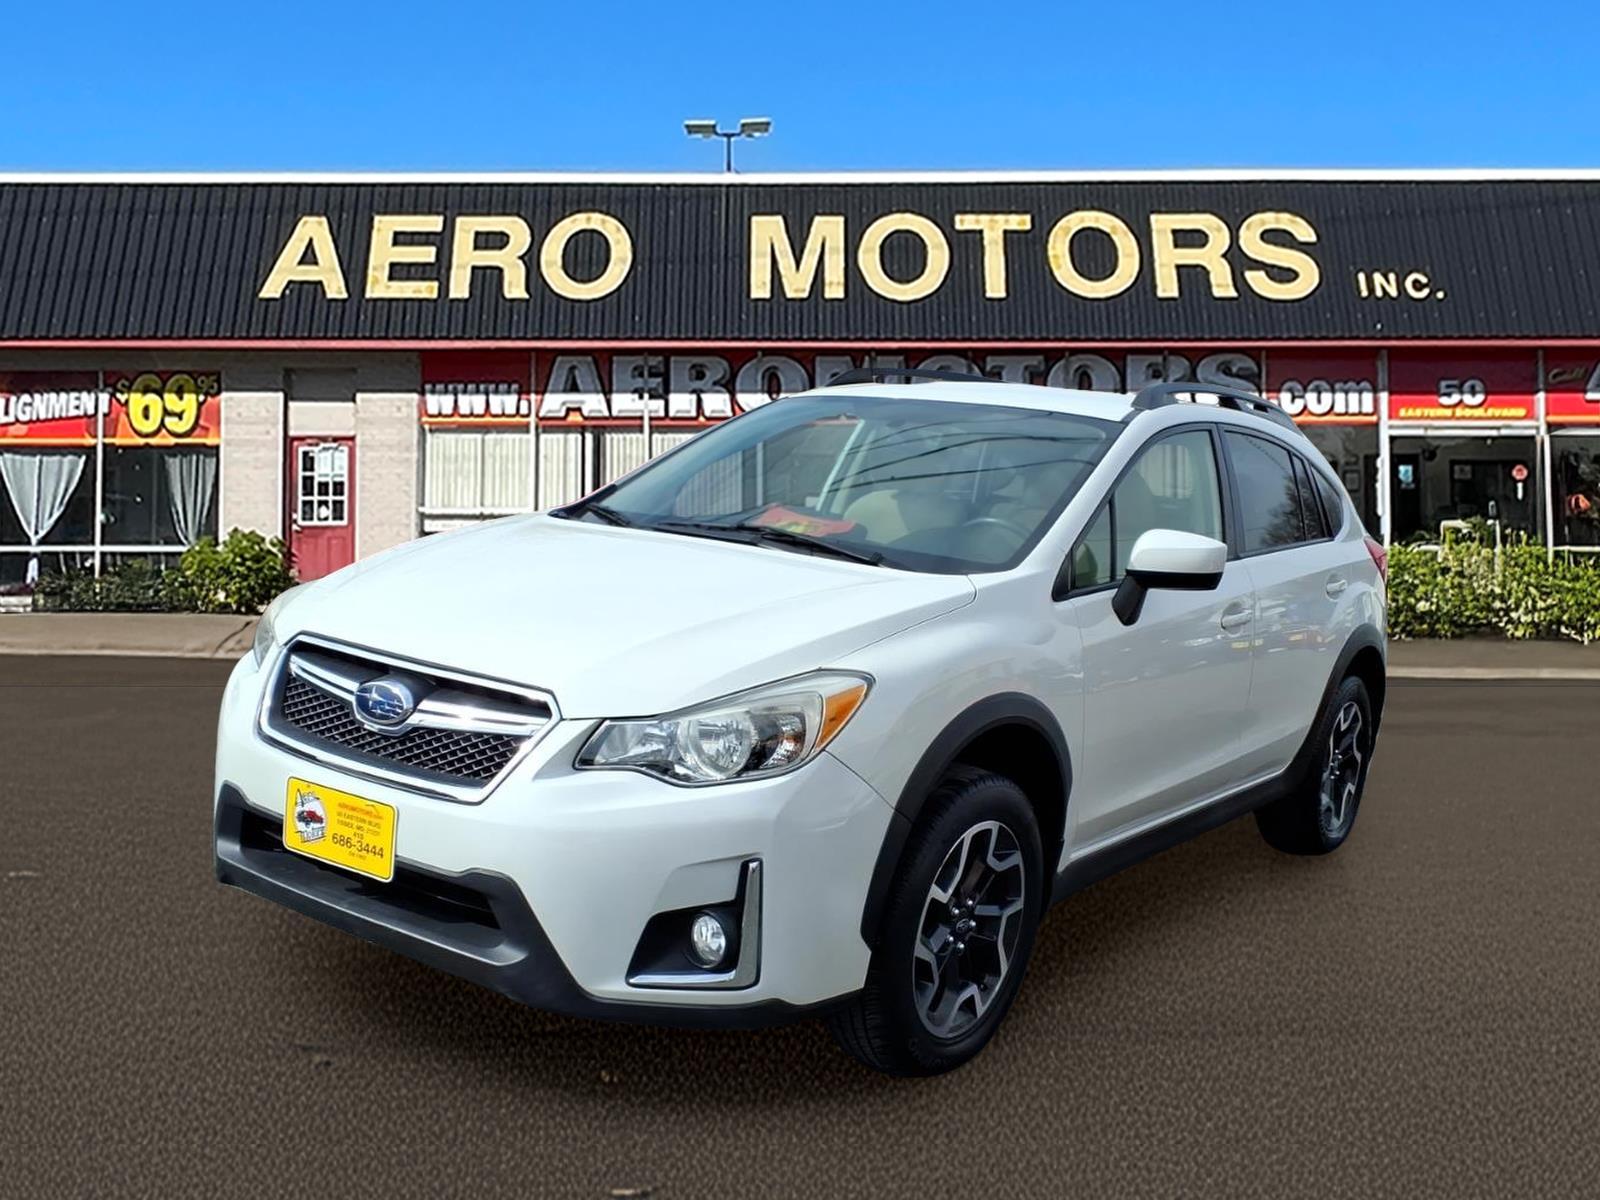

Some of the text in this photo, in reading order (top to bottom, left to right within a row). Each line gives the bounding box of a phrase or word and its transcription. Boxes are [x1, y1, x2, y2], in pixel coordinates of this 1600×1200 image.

[258, 209, 1448, 302] AERO MOTORS INC.
[1438, 378, 1487, 406] 50
[1399, 407, 1528, 418] EASTERN BOULEVARD
[331, 832, 384, 859] 686-3444
